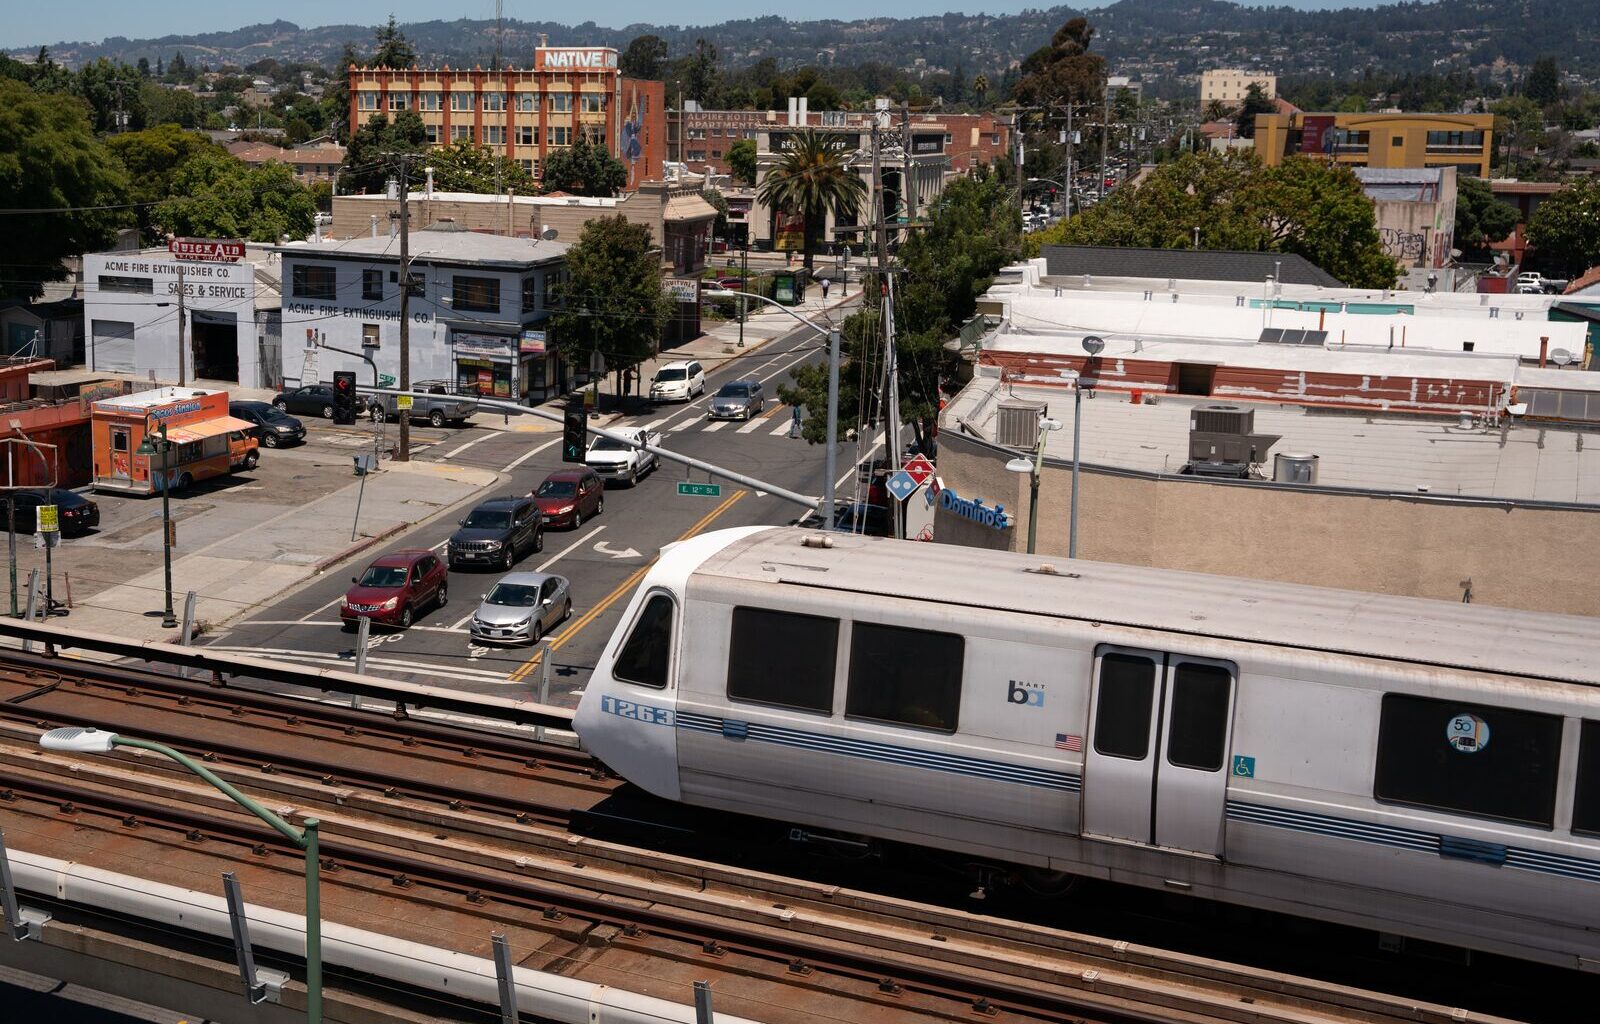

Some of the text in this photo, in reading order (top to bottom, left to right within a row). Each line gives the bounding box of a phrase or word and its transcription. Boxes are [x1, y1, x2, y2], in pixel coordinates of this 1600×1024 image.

[544, 51, 603, 67] NATIVE
[687, 113, 724, 121] ALPINE
[687, 121, 760, 129] APARTMENTS
[172, 241, 240, 257] QUICK AID
[105, 261, 128, 271] ACME
[132, 263, 149, 273] FIRE
[217, 268, 230, 278] CO.
[168, 282, 245, 298] SAES & SERVICE
[288, 302, 430, 323] ACME FIRE EXTINGUISHE CO.
[943, 489, 1008, 529] Domino's
[604, 698, 674, 726] 1263
[1455, 719, 1471, 731] 50
